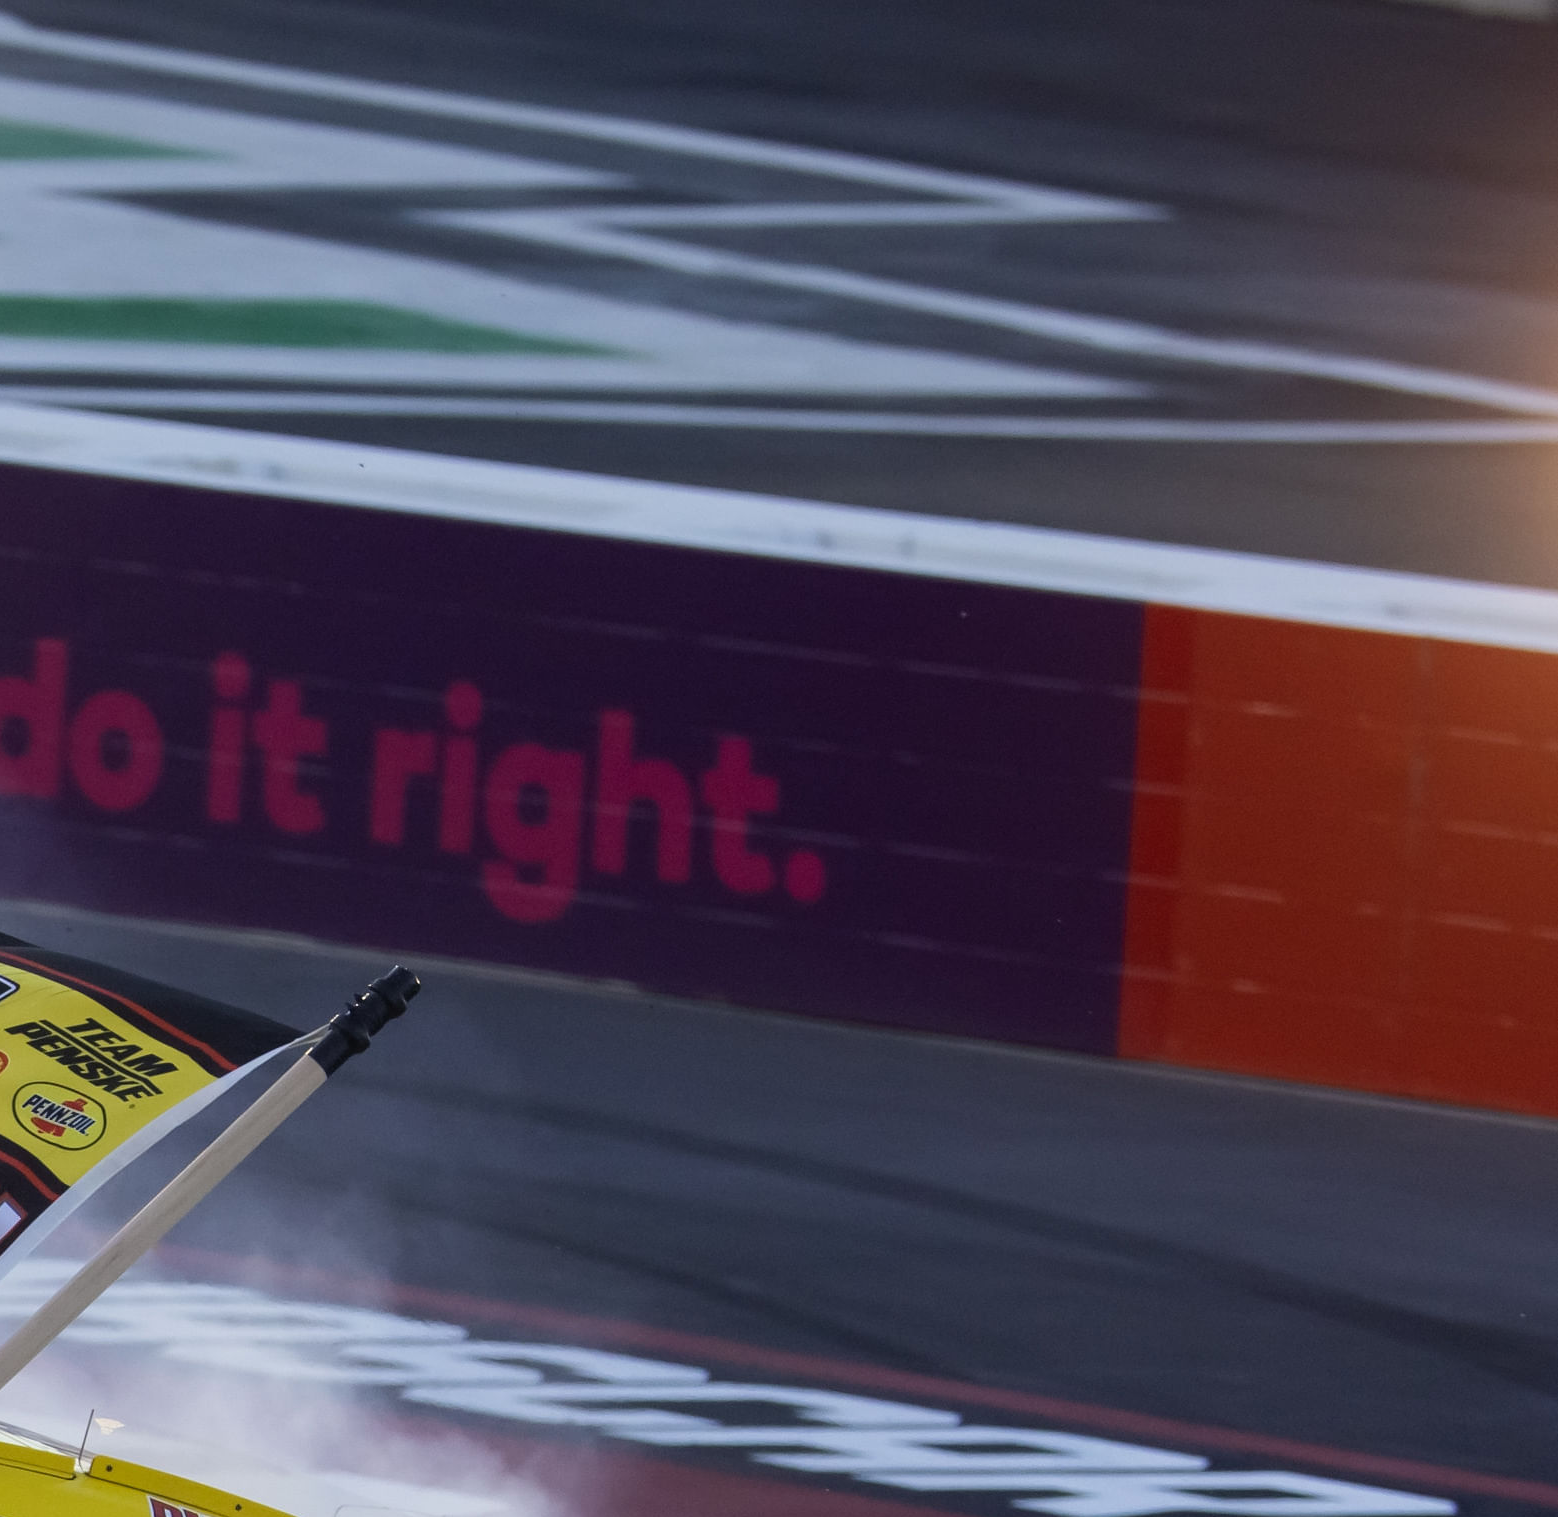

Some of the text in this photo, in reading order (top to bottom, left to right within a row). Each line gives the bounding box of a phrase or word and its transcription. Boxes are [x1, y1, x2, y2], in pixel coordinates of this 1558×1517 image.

[205, 653, 326, 836] it
[369, 679, 828, 925] right.
[4, 1021, 154, 1103] PENSKE
[65, 1018, 179, 1076] TEAM
[22, 1094, 96, 1136] PENNZOIL
